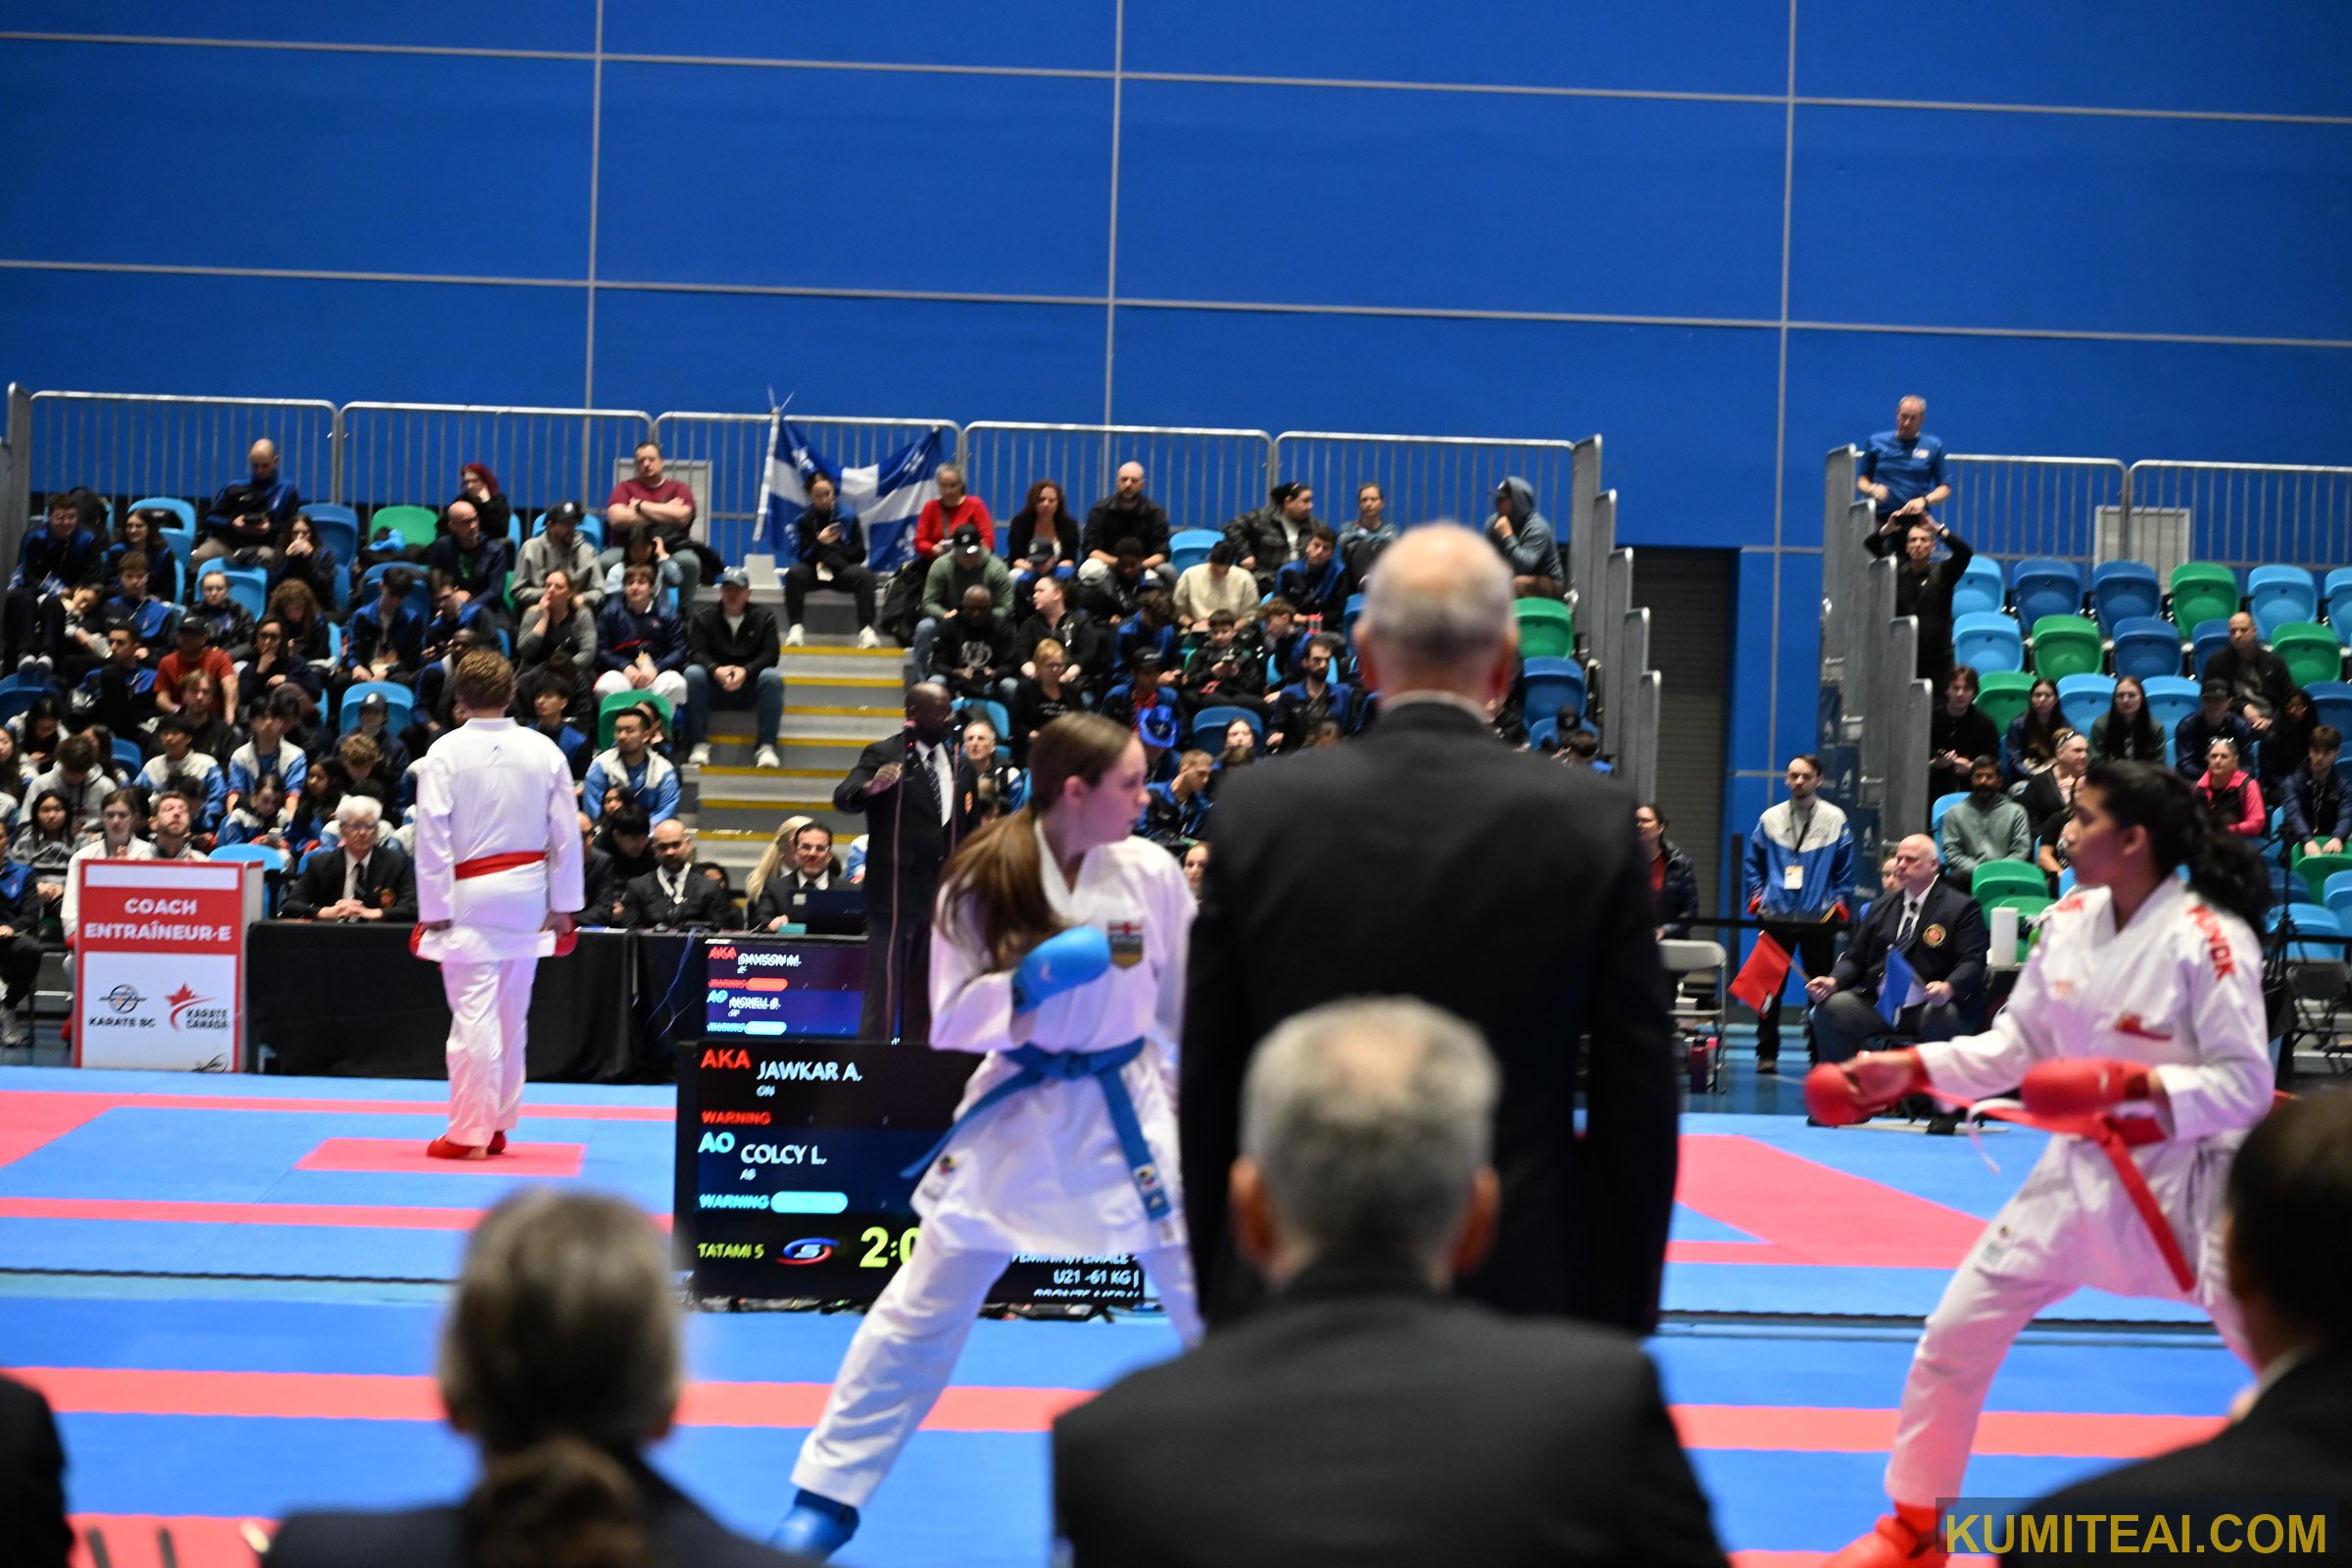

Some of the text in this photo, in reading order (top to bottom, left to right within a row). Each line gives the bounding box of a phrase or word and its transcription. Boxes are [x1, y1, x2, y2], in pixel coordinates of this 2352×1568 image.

[124, 898, 197, 915] COACH
[708, 947, 737, 959] AKA
[706, 990, 728, 1004] AO
[185, 1008, 228, 1019] KARATE
[88, 1017, 157, 1028] KARATE BC
[185, 1020, 228, 1030] CANADA
[700, 1049, 752, 1069] AKA
[756, 1060, 863, 1082] JAWKAR A.
[756, 1085, 776, 1097] ON
[701, 1111, 772, 1125] WARNING
[697, 1132, 736, 1153] AO
[740, 1144, 827, 1165] COLCY L.
[699, 1194, 770, 1209] WARNING
[697, 1243, 752, 1258] TATAMI
[1053, 1269, 1081, 1285] U21
[1110, 1269, 1132, 1286] KG
